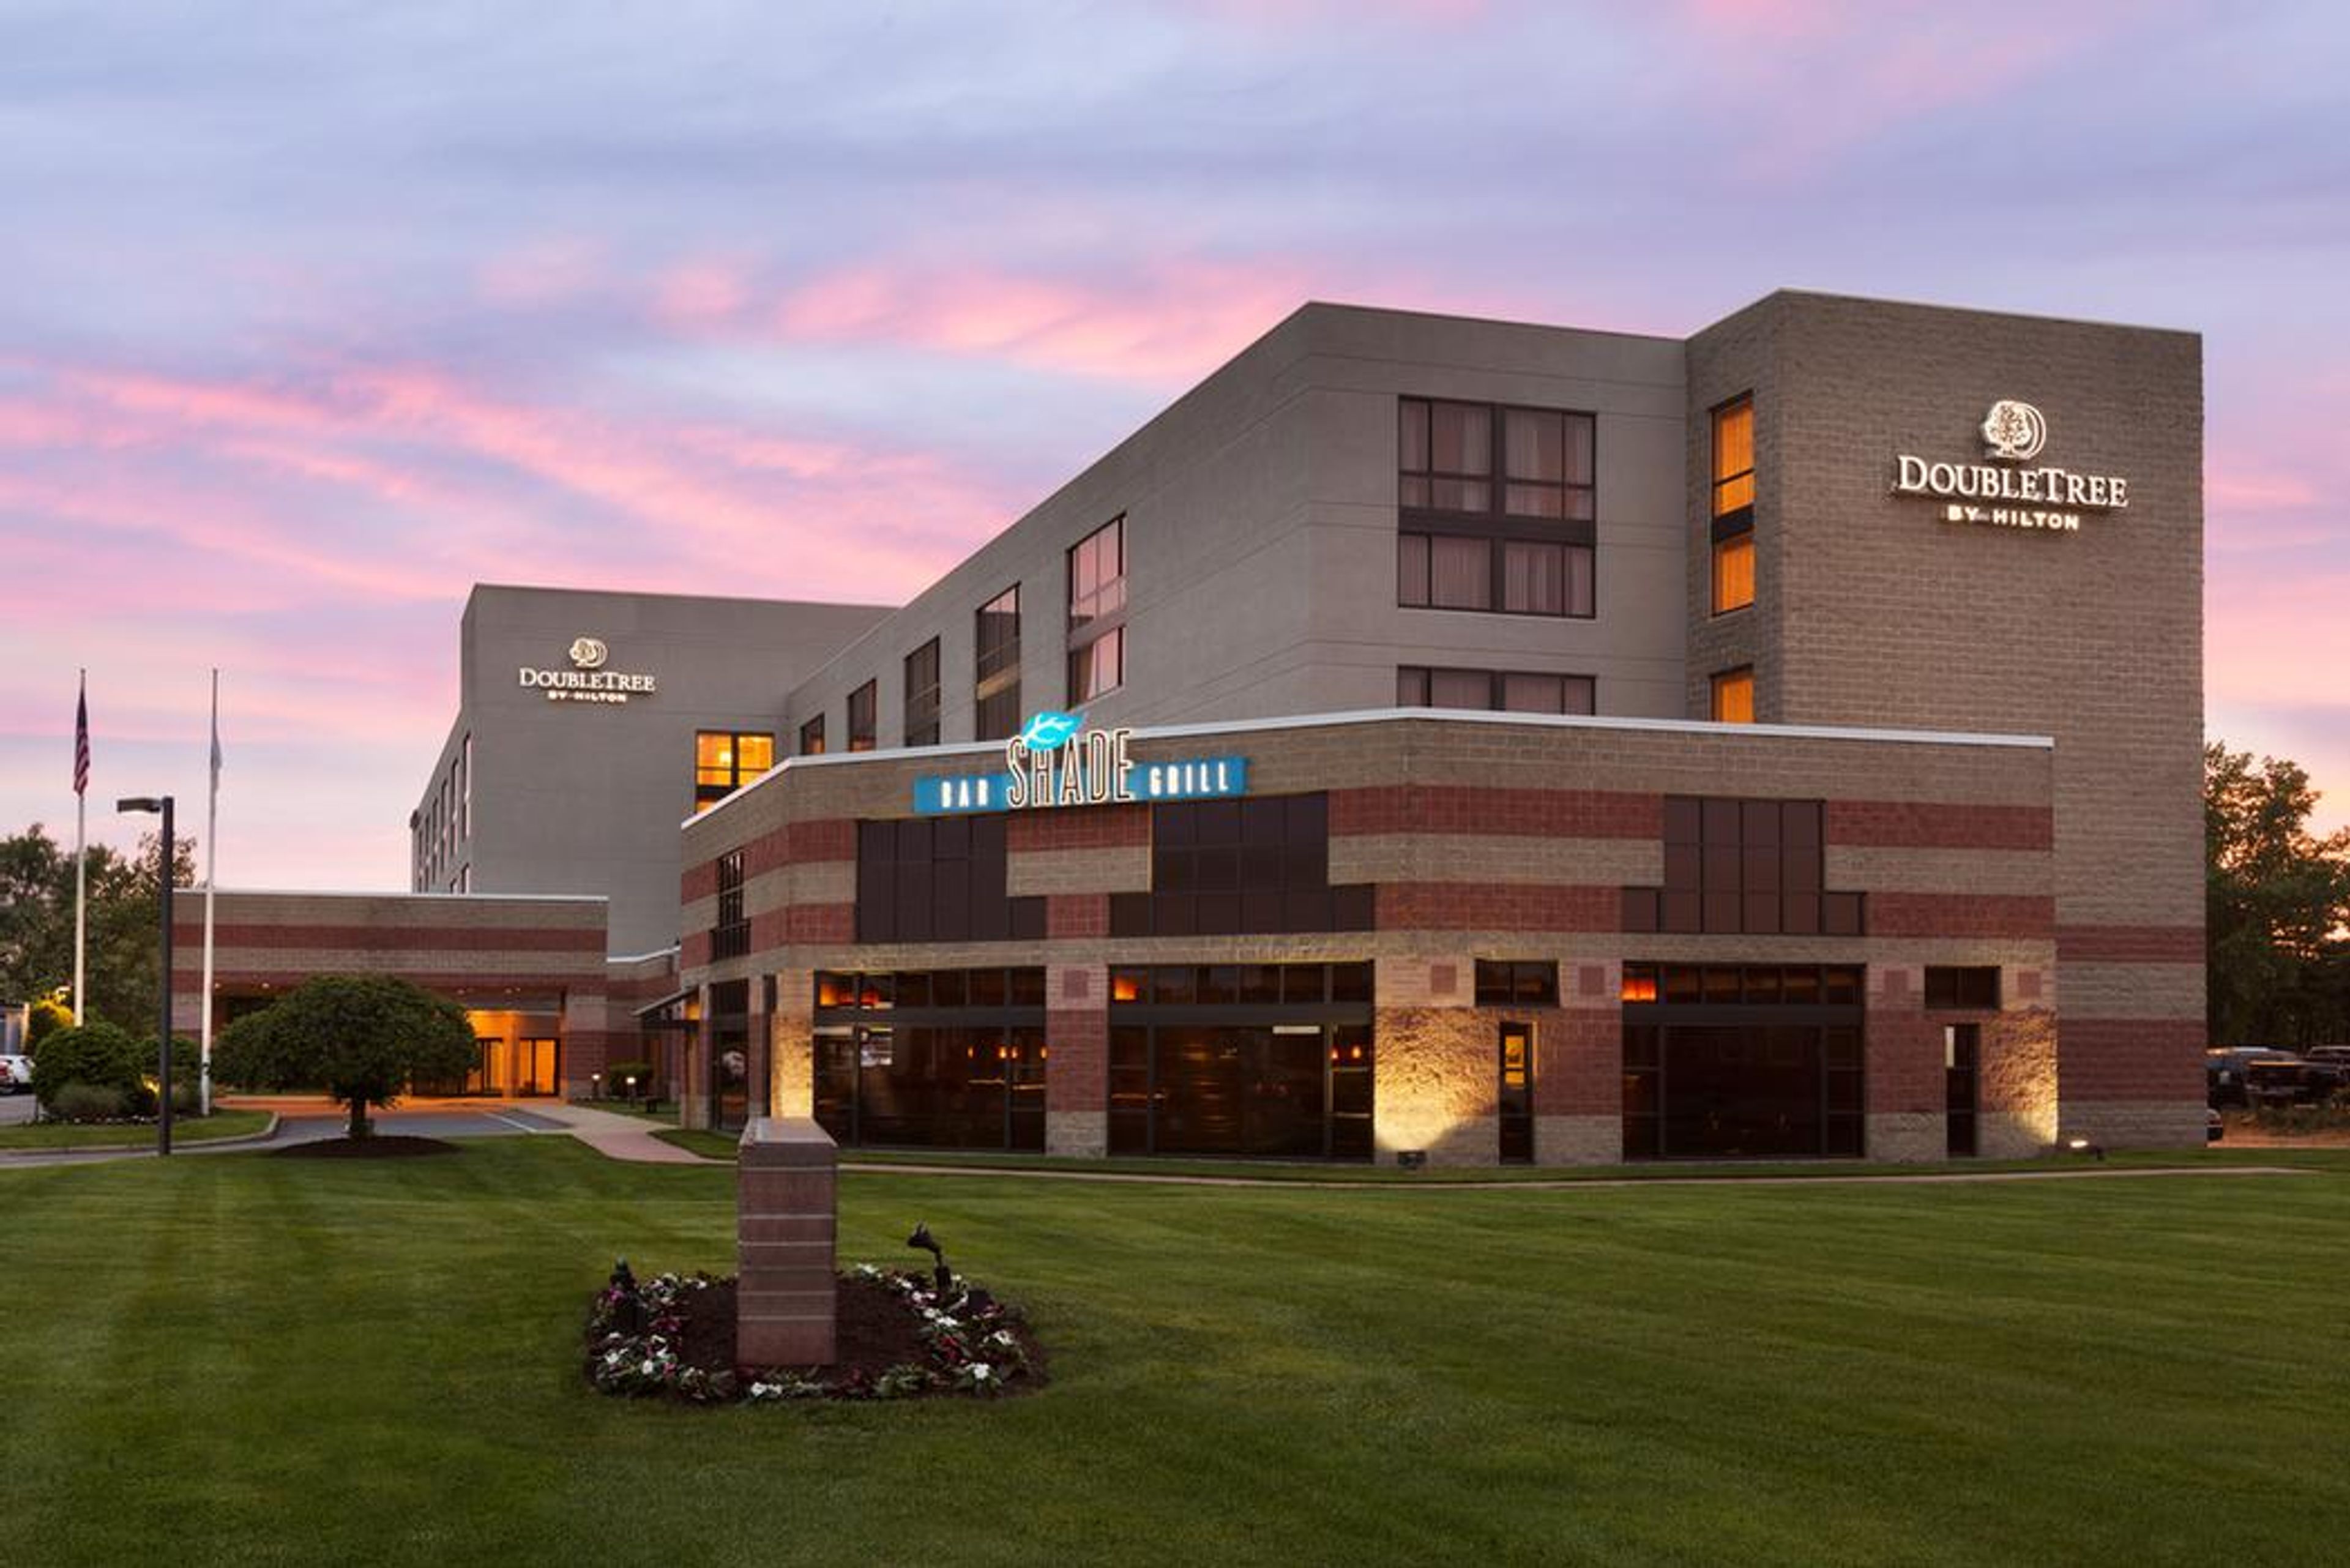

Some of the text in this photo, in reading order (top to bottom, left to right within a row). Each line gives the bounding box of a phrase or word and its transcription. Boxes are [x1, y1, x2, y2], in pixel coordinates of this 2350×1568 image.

[1898, 455, 2129, 507] DOUBLETREE
[1948, 505, 2080, 531] BY HILTON
[520, 668, 655, 692] DOUBLETREE
[548, 691, 627, 703] BY HILTON
[941, 730, 1229, 808] BAR SHADE GRILL
